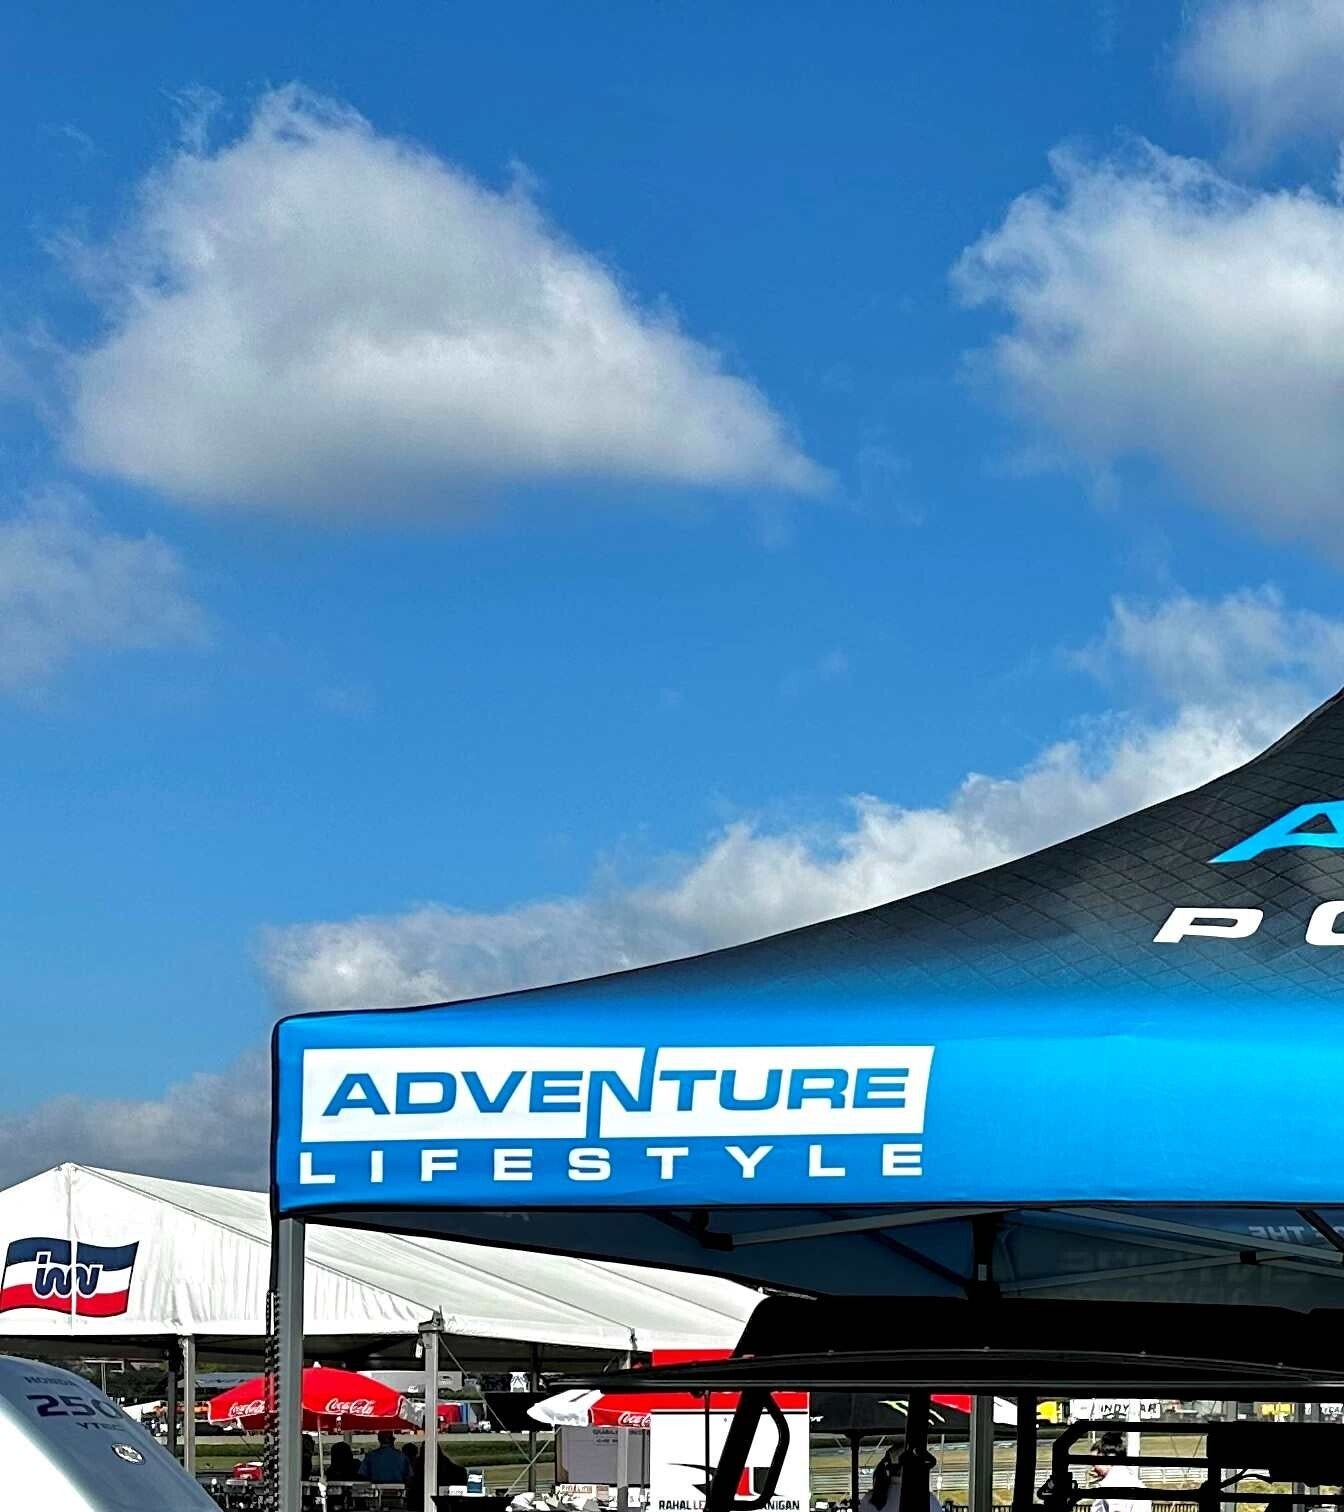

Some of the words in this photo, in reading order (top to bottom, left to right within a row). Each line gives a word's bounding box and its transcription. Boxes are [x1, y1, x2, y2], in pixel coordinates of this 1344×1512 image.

[322, 1047, 910, 1139] ADVENTURE
[299, 1143, 923, 1184] LIFESTYLE
[26, 1394, 123, 1419] 250
[325, 1398, 375, 1416] Coca-Cola
[1100, 1403, 1157, 1413] INDYAR
[618, 1412, 651, 1428] Coca-C
[658, 1500, 692, 1510] RAHAL
[765, 1500, 800, 1510] NIGAN
